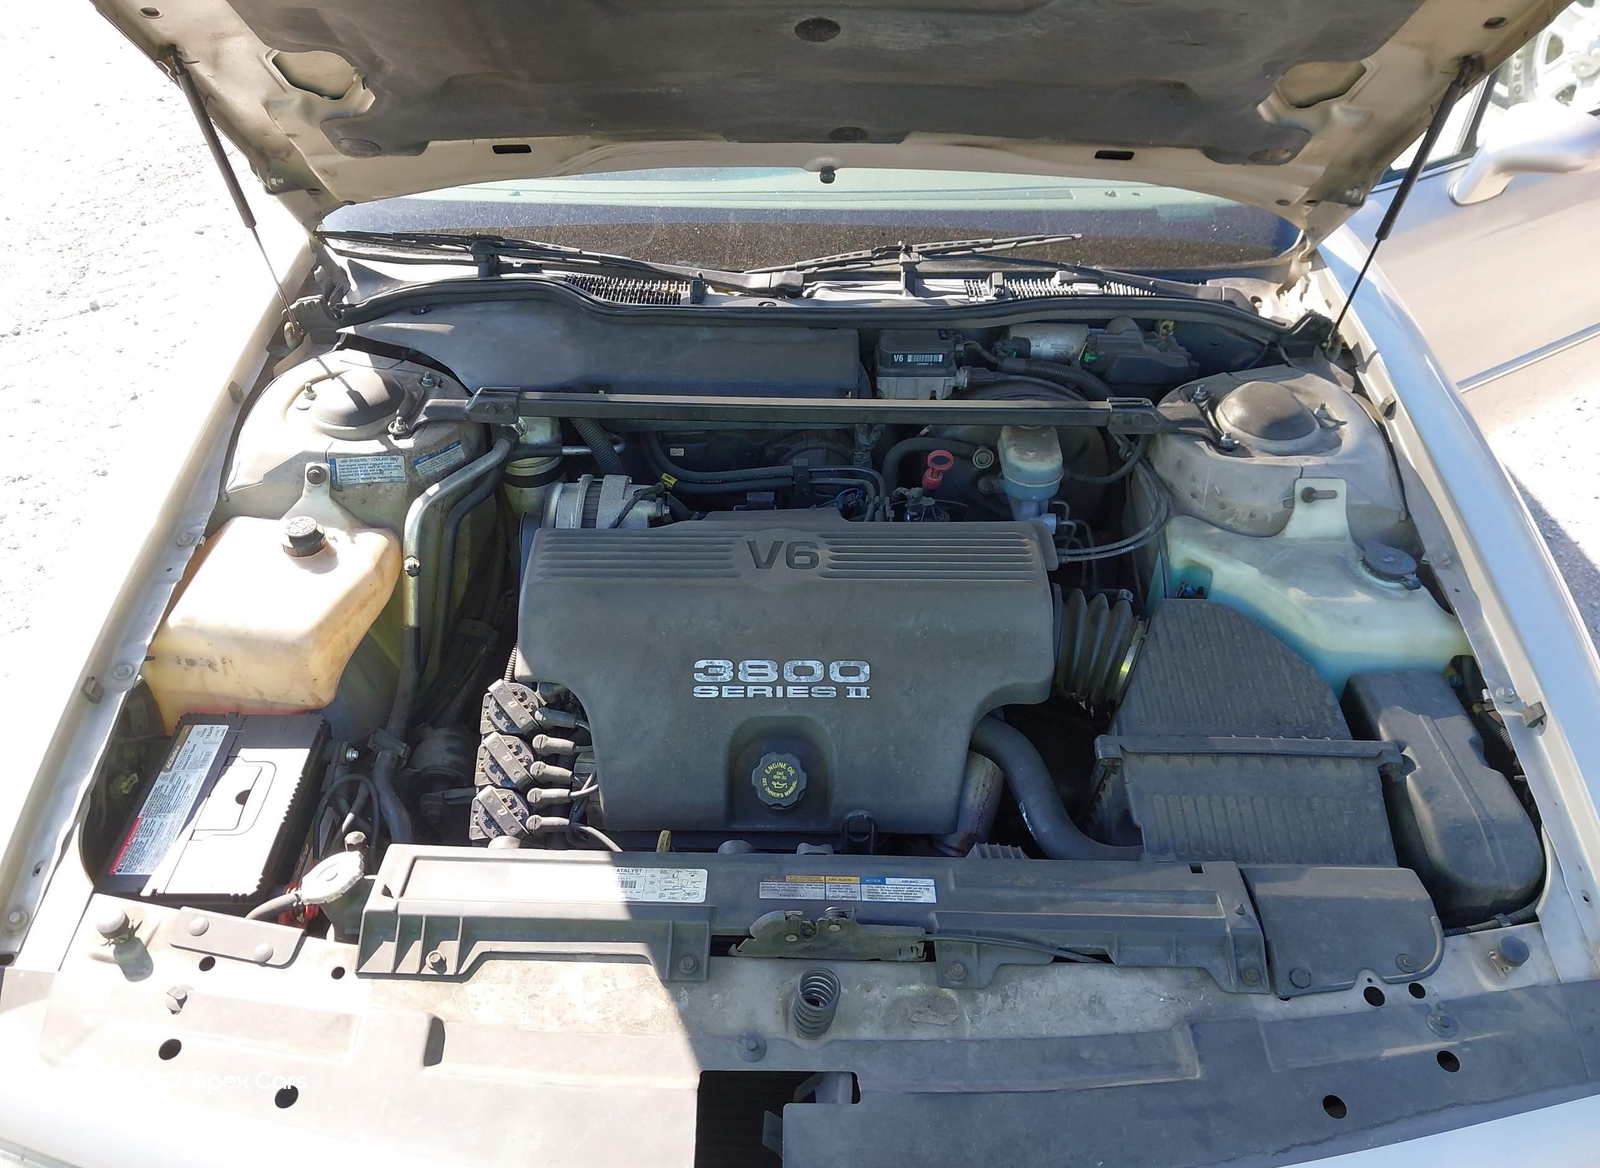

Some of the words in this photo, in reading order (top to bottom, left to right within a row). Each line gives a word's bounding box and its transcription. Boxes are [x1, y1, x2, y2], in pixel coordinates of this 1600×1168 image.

[893, 354, 904, 362] V6
[746, 540, 820, 570] V6
[693, 659, 871, 683] 3800
[692, 685, 837, 698] SERIES
[846, 686, 871, 699] II
[166, 745, 181, 769] ACDelco
[764, 762, 788, 774] ENGINE
[787, 766, 796, 777] OIL
